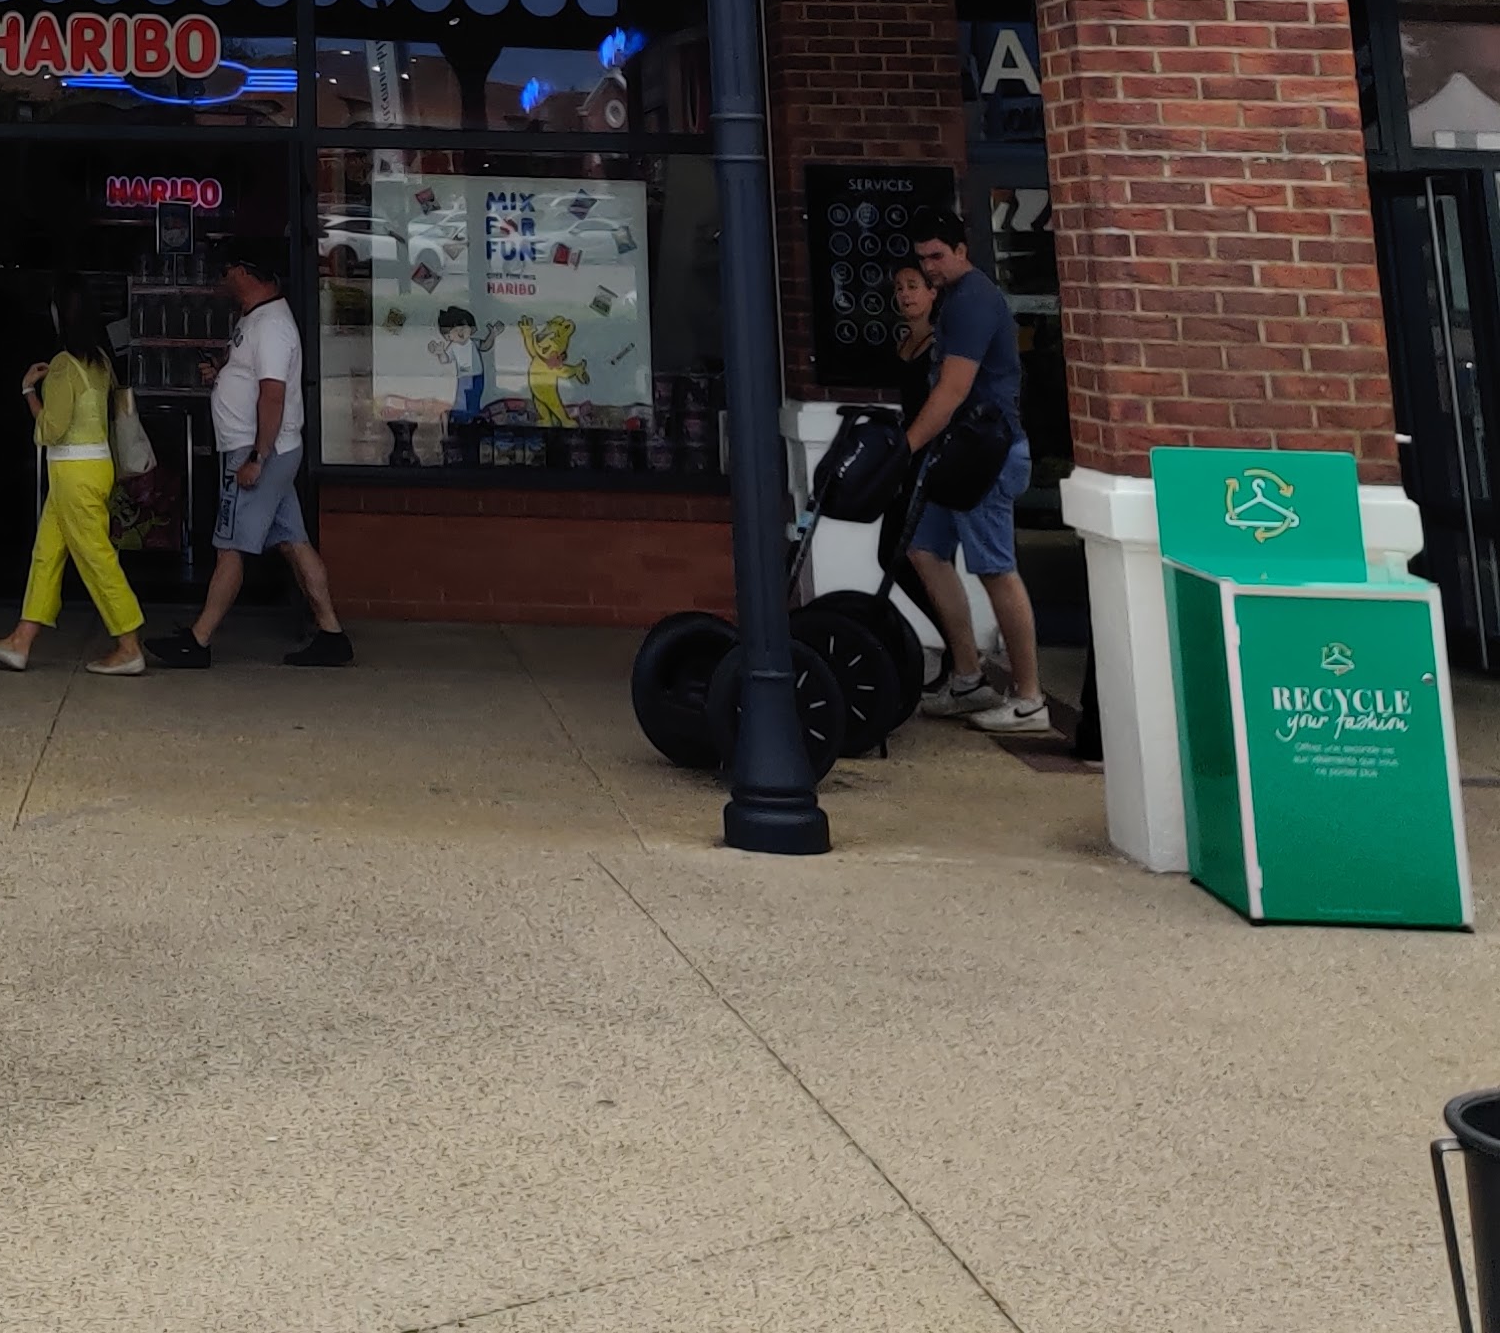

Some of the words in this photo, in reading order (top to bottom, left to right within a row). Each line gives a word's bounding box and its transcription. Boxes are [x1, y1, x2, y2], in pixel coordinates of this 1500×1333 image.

[107, 177, 221, 208] HARIBO
[848, 178, 914, 192] SERVICES
[486, 191, 536, 213] MIX
[486, 239, 537, 262] FUN
[487, 282, 536, 296] HARIBO
[1271, 686, 1412, 714] RECYCLE
[1275, 713, 1330, 743] your
[1333, 710, 1410, 740] fashion
